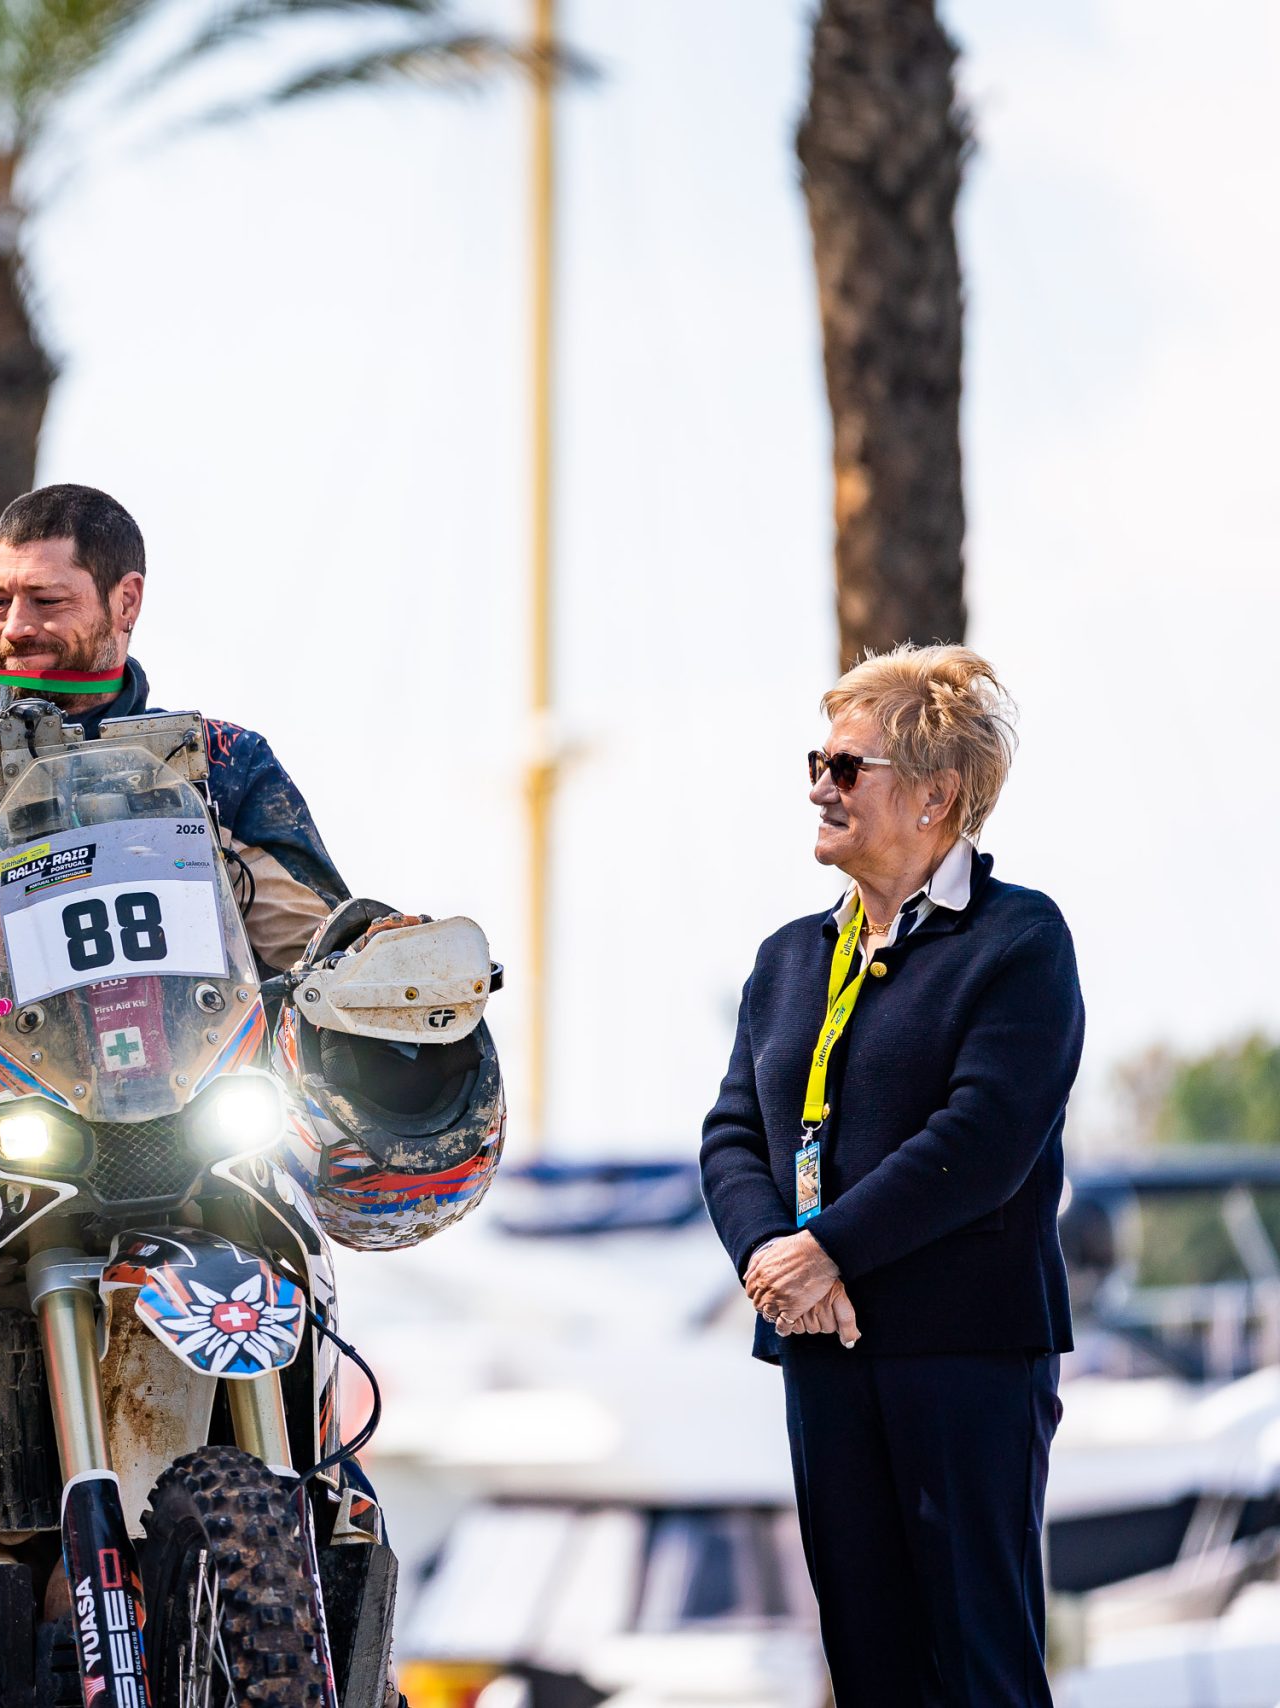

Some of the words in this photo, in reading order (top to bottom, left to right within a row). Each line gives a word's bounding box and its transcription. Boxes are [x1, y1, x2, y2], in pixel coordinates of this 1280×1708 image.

[176, 824, 205, 835] 2026
[7, 848, 89, 882] RALLY-RAID
[50, 860, 87, 874] PORTUGAL
[62, 892, 168, 972] 88
[843, 925, 859, 956] ultimate
[94, 1005, 114, 1015] First
[115, 1002, 131, 1011] Aid
[132, 1000, 145, 1008] Kit
[818, 1028, 836, 1068] ultimate
[76, 1576, 102, 1673] YUASA
[127, 1594, 136, 1626] ENERGY
[131, 1631, 142, 1675] EDELWEISS
